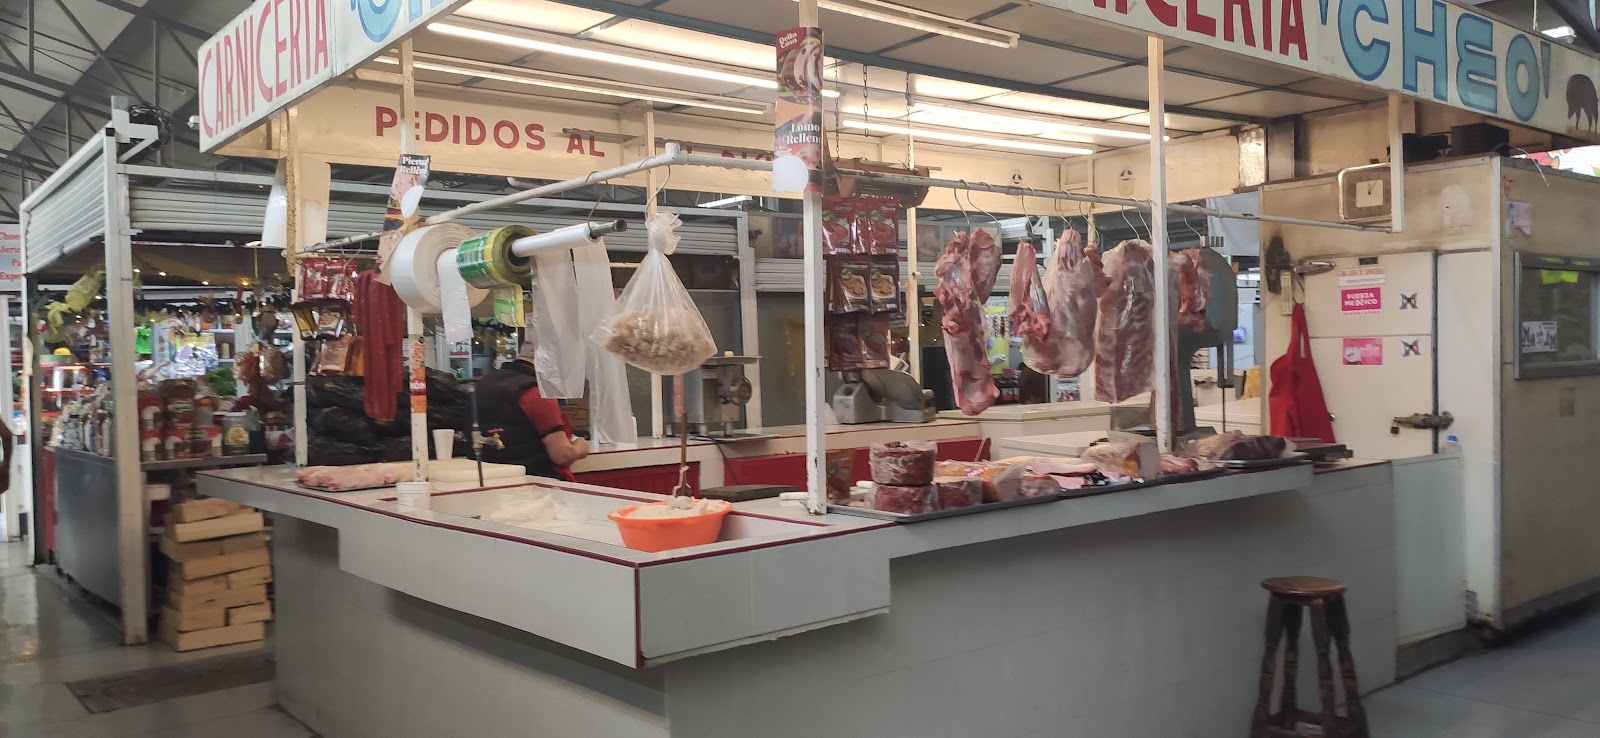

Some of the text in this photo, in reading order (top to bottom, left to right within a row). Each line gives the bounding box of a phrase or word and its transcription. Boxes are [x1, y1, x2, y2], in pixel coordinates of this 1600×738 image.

[375, 105, 605, 158] PDIDOS AL
[791, 123, 820, 133] Lomo
